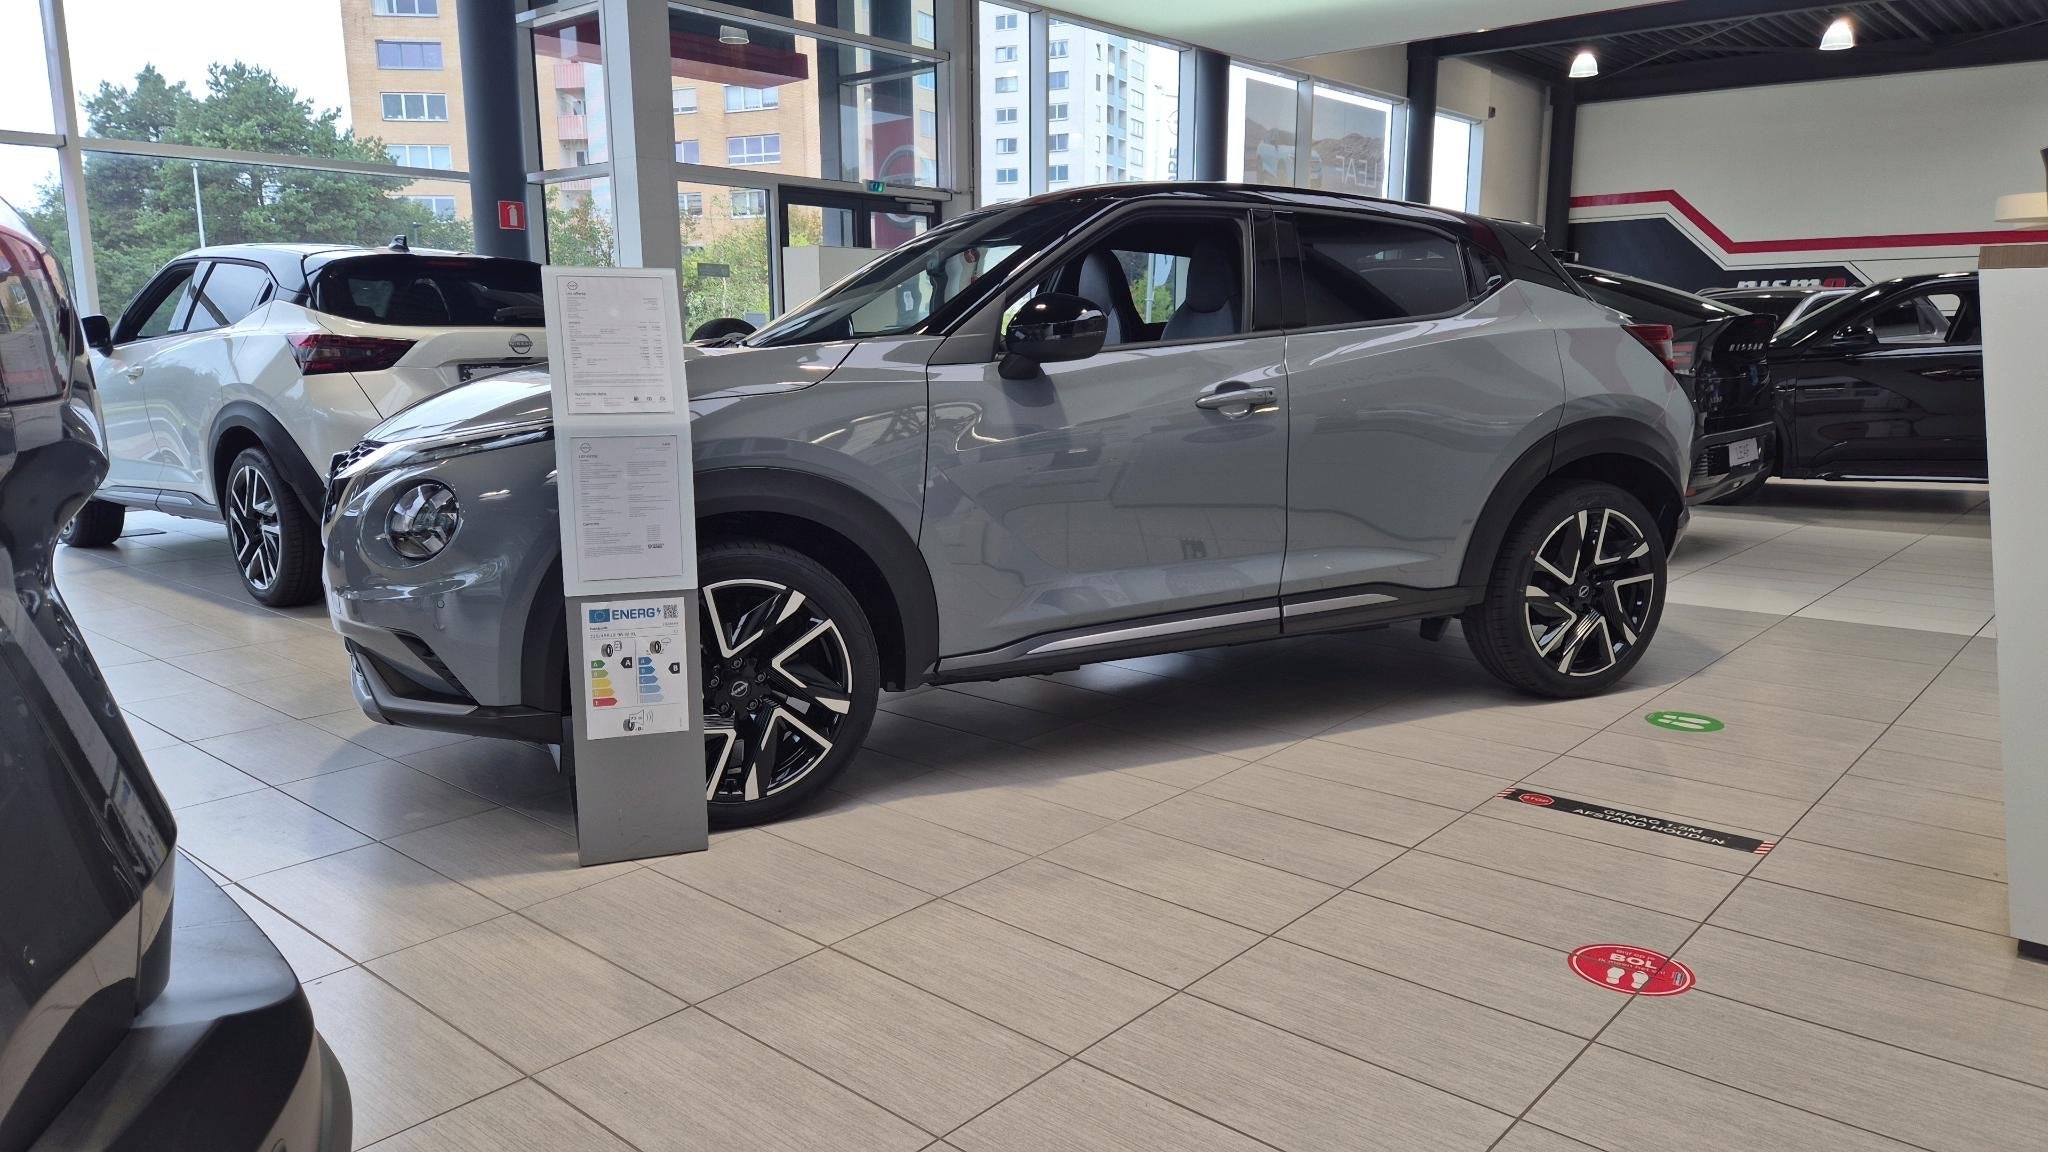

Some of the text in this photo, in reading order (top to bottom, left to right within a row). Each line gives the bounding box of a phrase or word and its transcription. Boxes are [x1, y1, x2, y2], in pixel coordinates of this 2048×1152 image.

[611, 608, 655, 620] ENERG
[1523, 795, 1549, 803] STOP
[1604, 809, 1660, 825] GRAAG
[1573, 809, 1725, 845] AFSTAND HOUDEN
[1609, 952, 1657, 969] BOL
